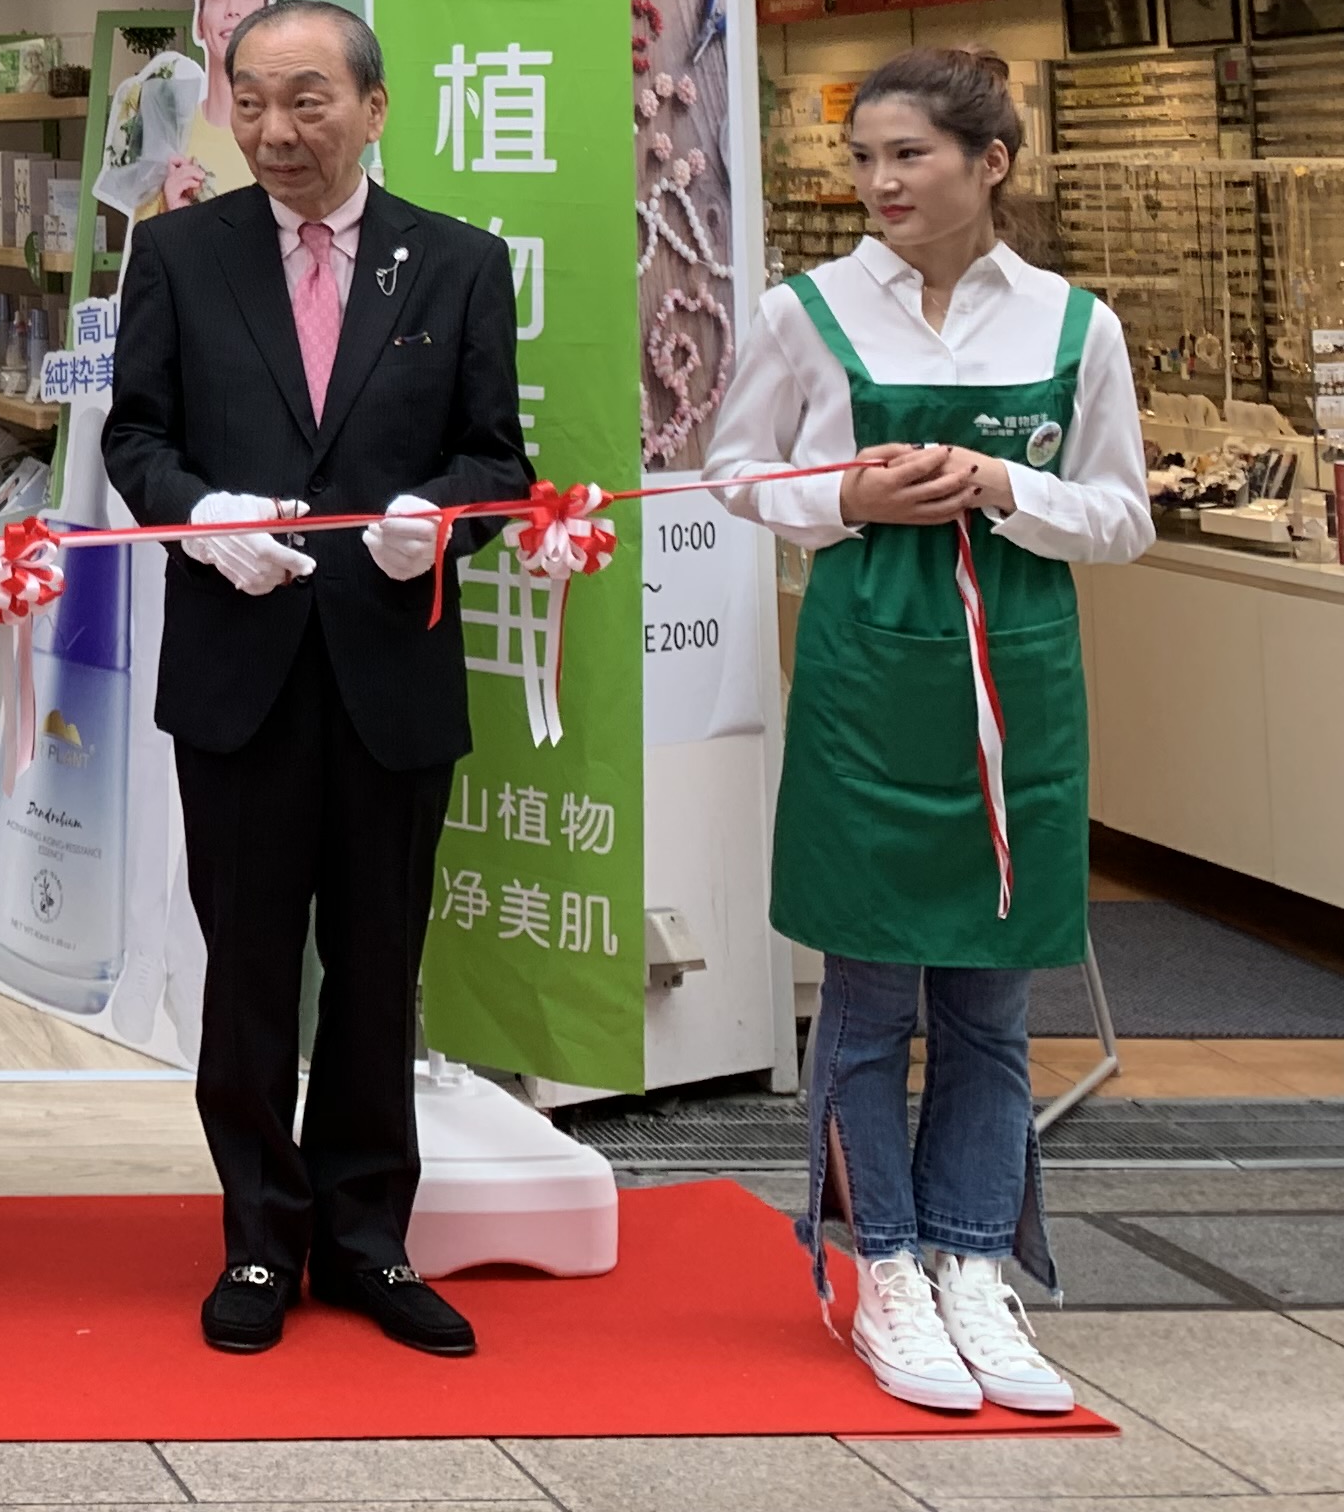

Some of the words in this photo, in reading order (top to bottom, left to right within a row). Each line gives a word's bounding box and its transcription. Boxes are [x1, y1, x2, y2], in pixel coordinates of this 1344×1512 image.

[658, 520, 716, 554] 10:00
[660, 618, 720, 653] 20:00
[428, 865, 619, 957] 净美肌
